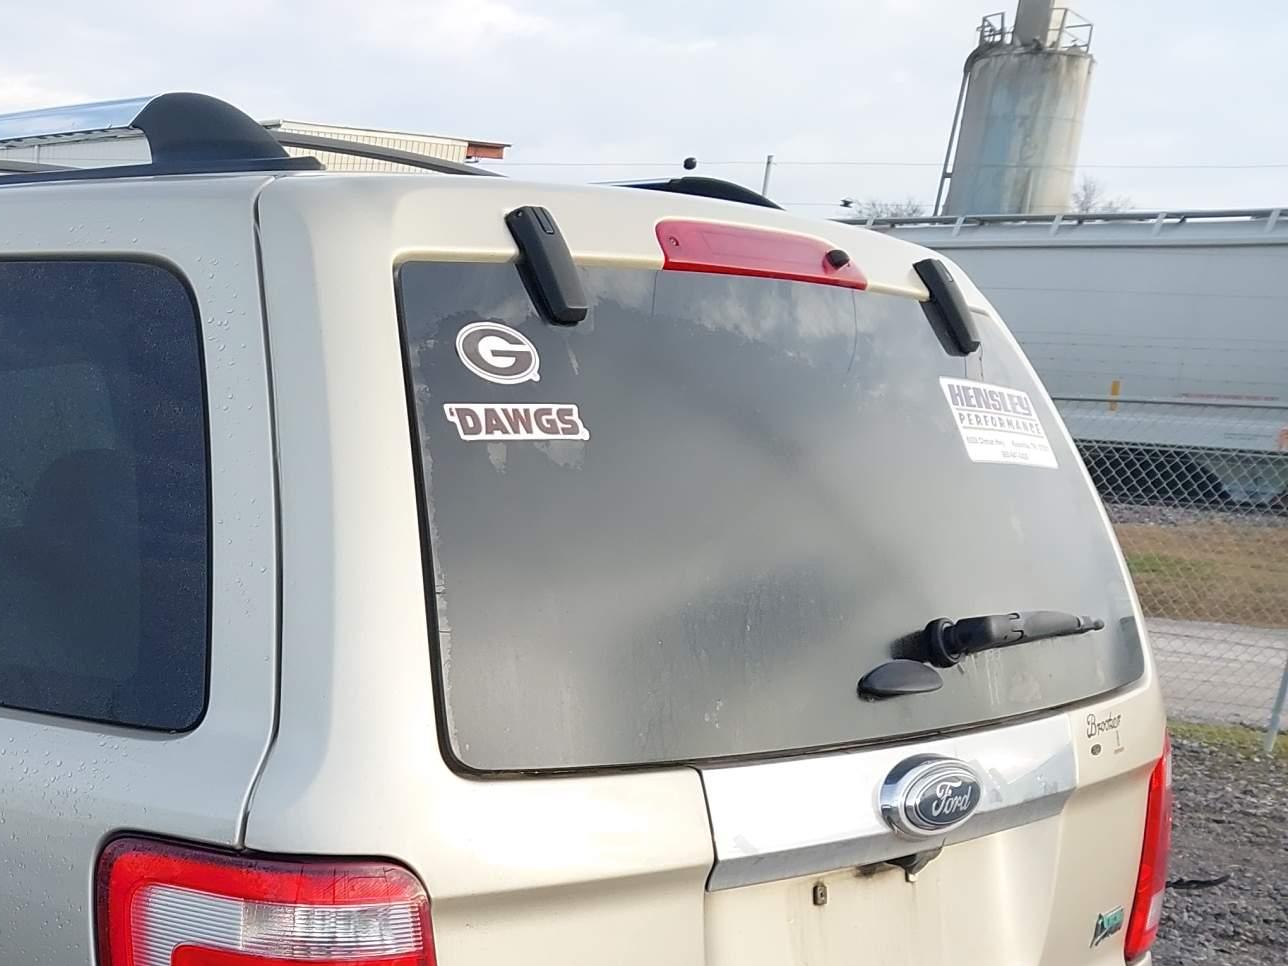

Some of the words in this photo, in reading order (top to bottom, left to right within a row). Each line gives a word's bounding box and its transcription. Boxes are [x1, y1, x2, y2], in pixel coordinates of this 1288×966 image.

[461, 327, 534, 377] G
[947, 383, 1033, 417] HENSLEY
[958, 412, 1043, 435] PERFORMANCE
[932, 780, 972, 817] Ford
